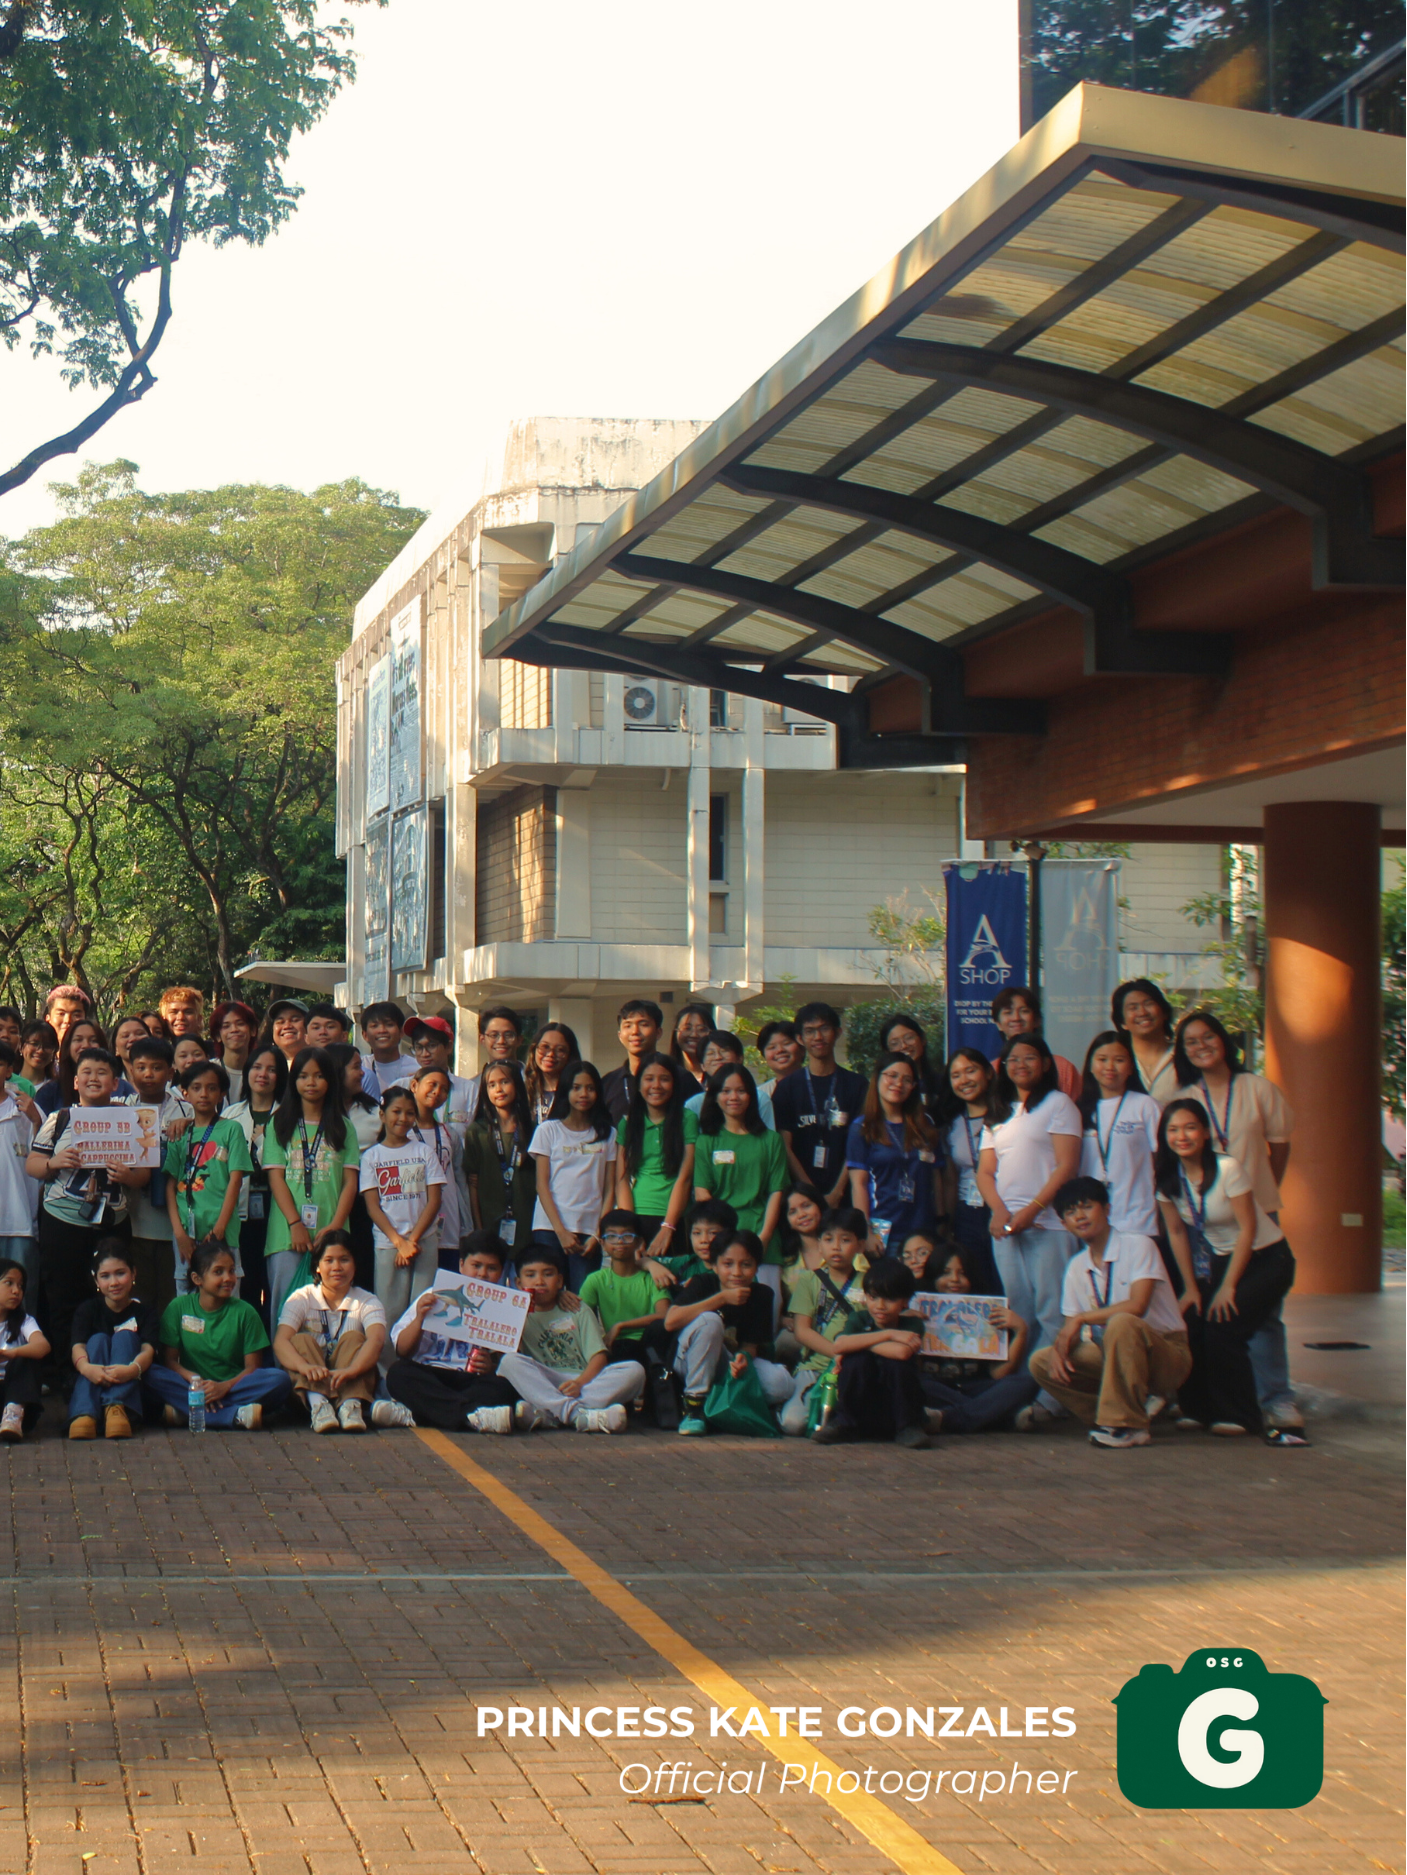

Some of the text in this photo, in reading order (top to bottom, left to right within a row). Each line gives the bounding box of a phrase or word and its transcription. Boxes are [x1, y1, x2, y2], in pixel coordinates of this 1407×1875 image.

[959, 968, 1012, 985] SHOP
[969, 1008, 988, 1016] YOUR
[961, 1017, 987, 1025] SCHOOL
[74, 1121, 131, 1135] GROUP 5B
[81, 1153, 135, 1164] CAPPUCCINA
[374, 1158, 410, 1168] GARFIELD
[385, 1194, 408, 1202] SINCE
[466, 1282, 528, 1309] GROUP 6A
[464, 1313, 518, 1337] TRALALERO
[468, 1325, 516, 1348] TRALALA
